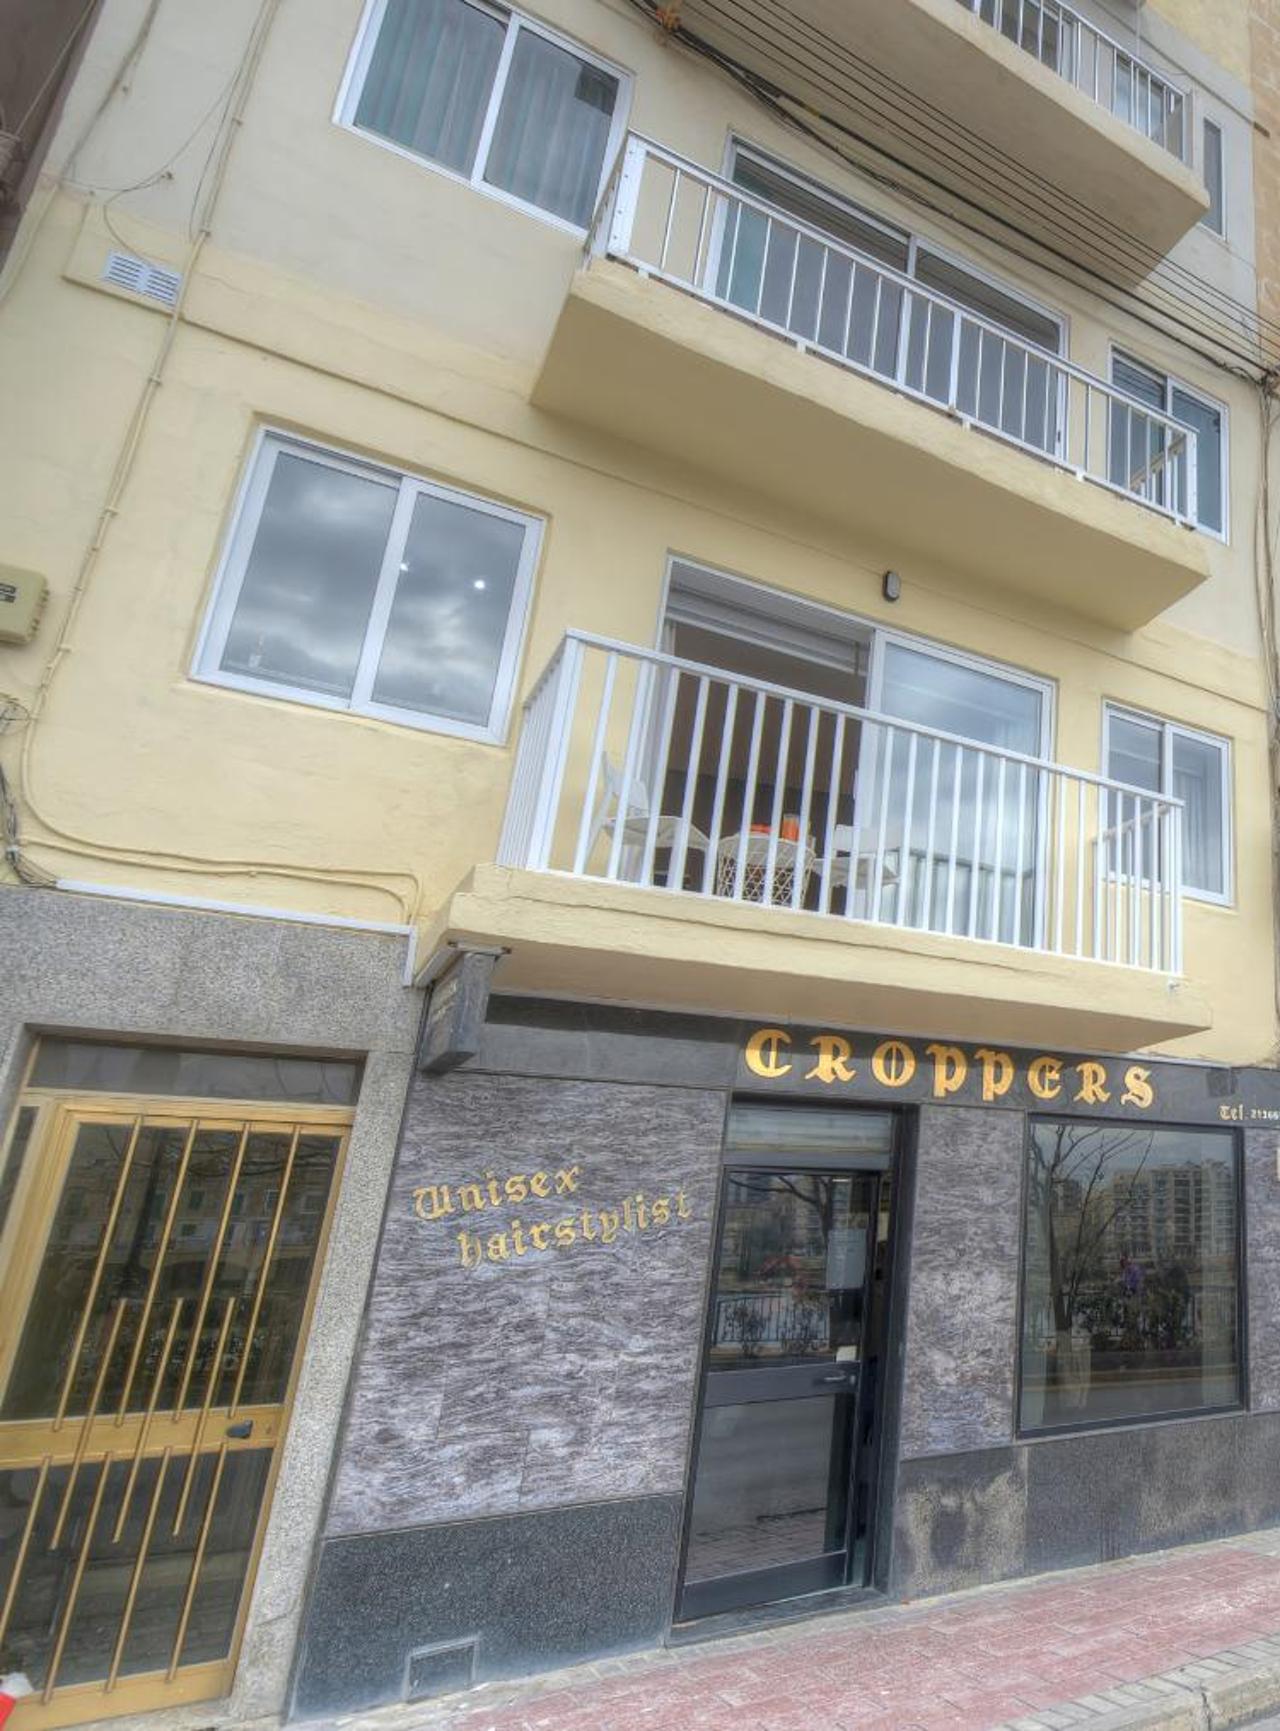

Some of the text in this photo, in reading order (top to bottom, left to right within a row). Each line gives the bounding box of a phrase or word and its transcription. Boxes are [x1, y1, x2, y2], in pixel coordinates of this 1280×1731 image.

[744, 1028, 1156, 1109] CROPPERS
[412, 1165, 583, 1220] Unisex
[457, 1190, 692, 1268] hairstylist
